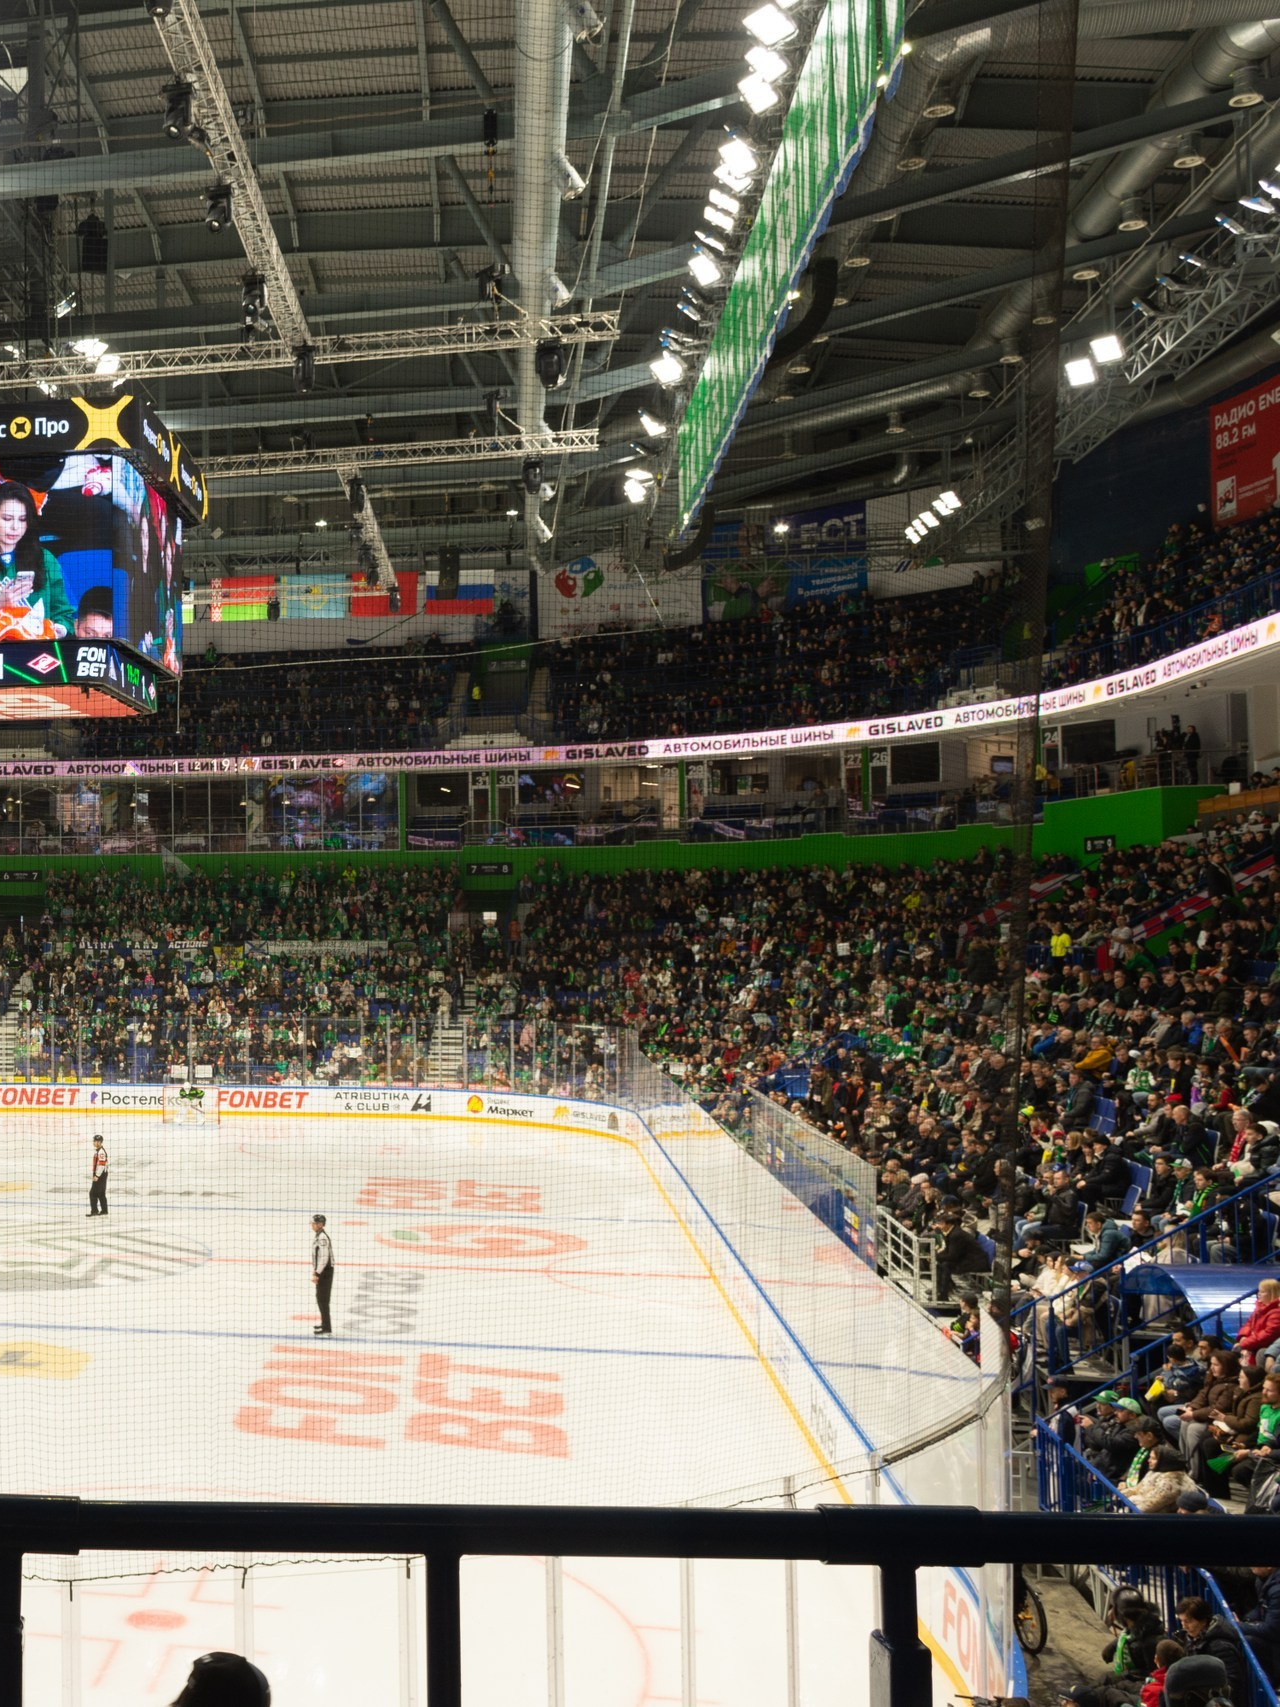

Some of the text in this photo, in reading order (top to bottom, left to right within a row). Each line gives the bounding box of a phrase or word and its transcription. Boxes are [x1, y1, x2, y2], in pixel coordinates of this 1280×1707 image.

[1215, 401, 1256, 430] РАДИО
[34, 417, 70, 436] Про
[1215, 422, 1256, 449] 88.2 FM
[77, 646, 107, 662] FON
[1106, 628, 1259, 696] GISLAVED АВТОМОБИЛЬНЫЕ ШИНЫ
[77, 662, 107, 678] BET
[868, 688, 1086, 736] GISLAVED АВТОМОБИЛЬНЫЕ ШИНЫ
[1044, 731, 1060, 743] 24
[565, 729, 834, 761] GISLAVED АВТОМОБИЛЬНЫЕ ШИНЫ
[356, 753, 481, 767] АВТОМОБИЛЬНЫЕ
[484, 750, 531, 765] ШИНЫ
[847, 753, 862, 765] 27
[872, 751, 888, 764] 26
[67, 762, 184, 774] АВТОМОЛЬНЫЕ
[499, 775, 515, 784] 30
[3, 872, 38, 880] 6 7
[471, 864, 509, 874] 7 8
[101, 1091, 183, 1105] Ростелек
[215, 1090, 309, 1109] FONBET
[334, 1091, 410, 1101] ATRIBUTIKA
[344, 1102, 390, 1111] & CLUB
[486, 1105, 534, 1118] Маркет
[572, 1111, 607, 1123] GISLAVED
[233, 1344, 407, 1450] FON
[404, 1352, 572, 1460] BET
